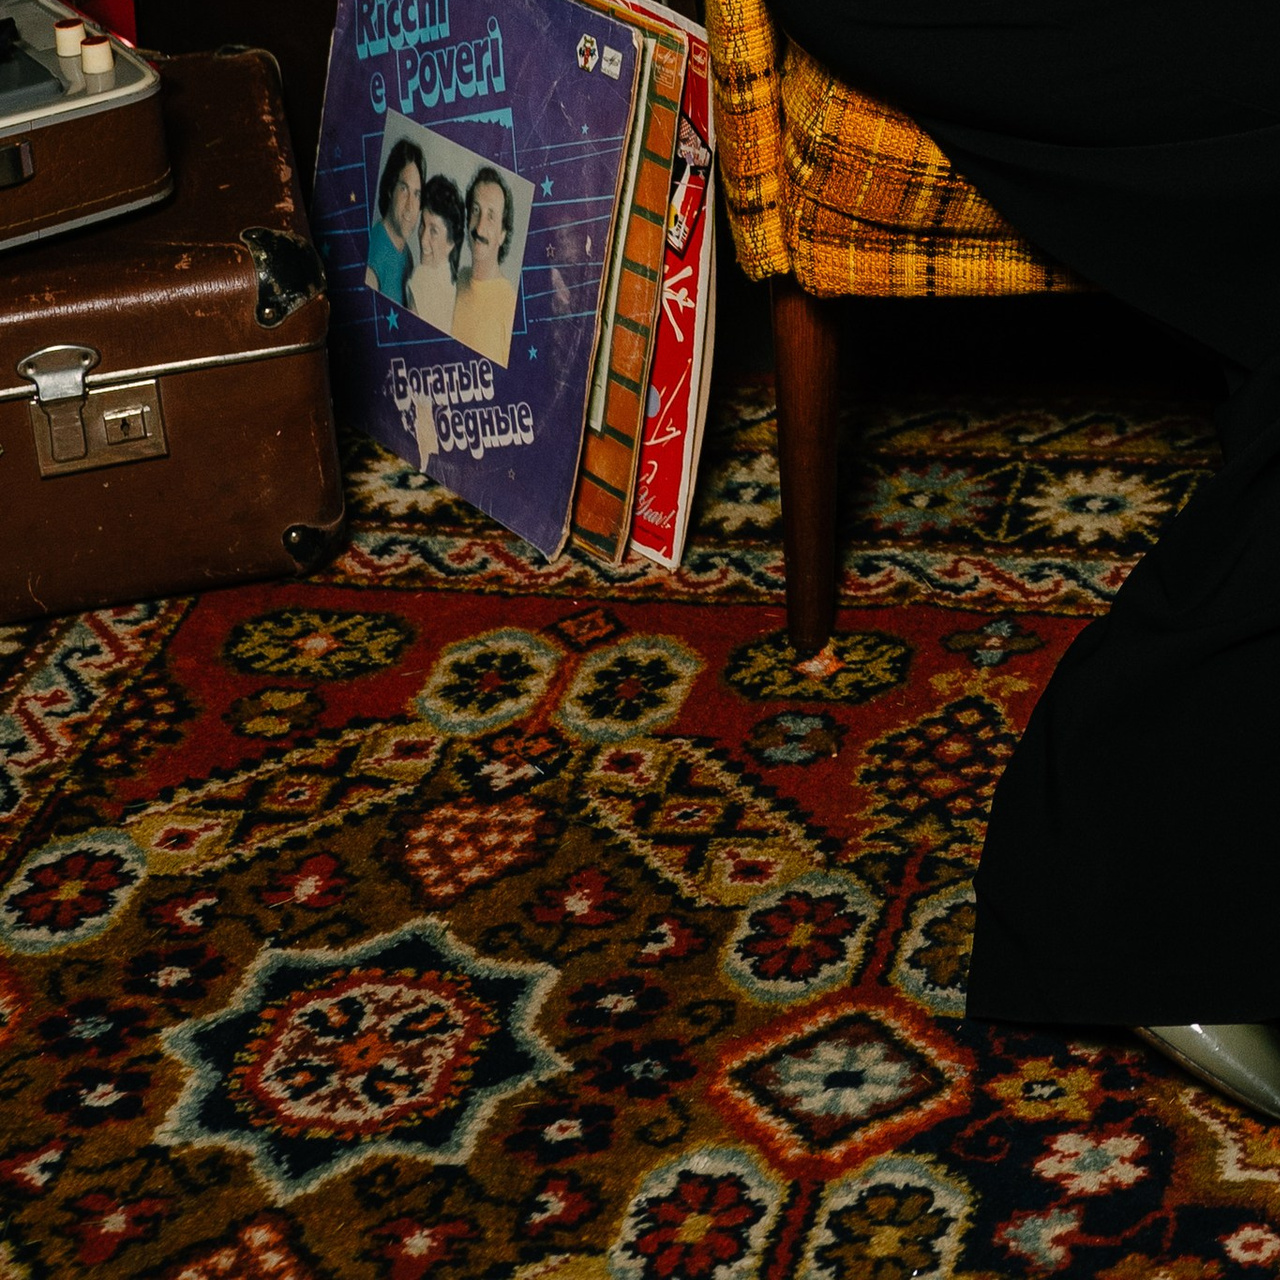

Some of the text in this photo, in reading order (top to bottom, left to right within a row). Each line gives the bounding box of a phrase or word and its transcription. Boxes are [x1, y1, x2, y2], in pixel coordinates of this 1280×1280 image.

[370, 15, 506, 115] e Poveri
[390, 357, 495, 411] Богатые
[435, 401, 535, 460] бедные
